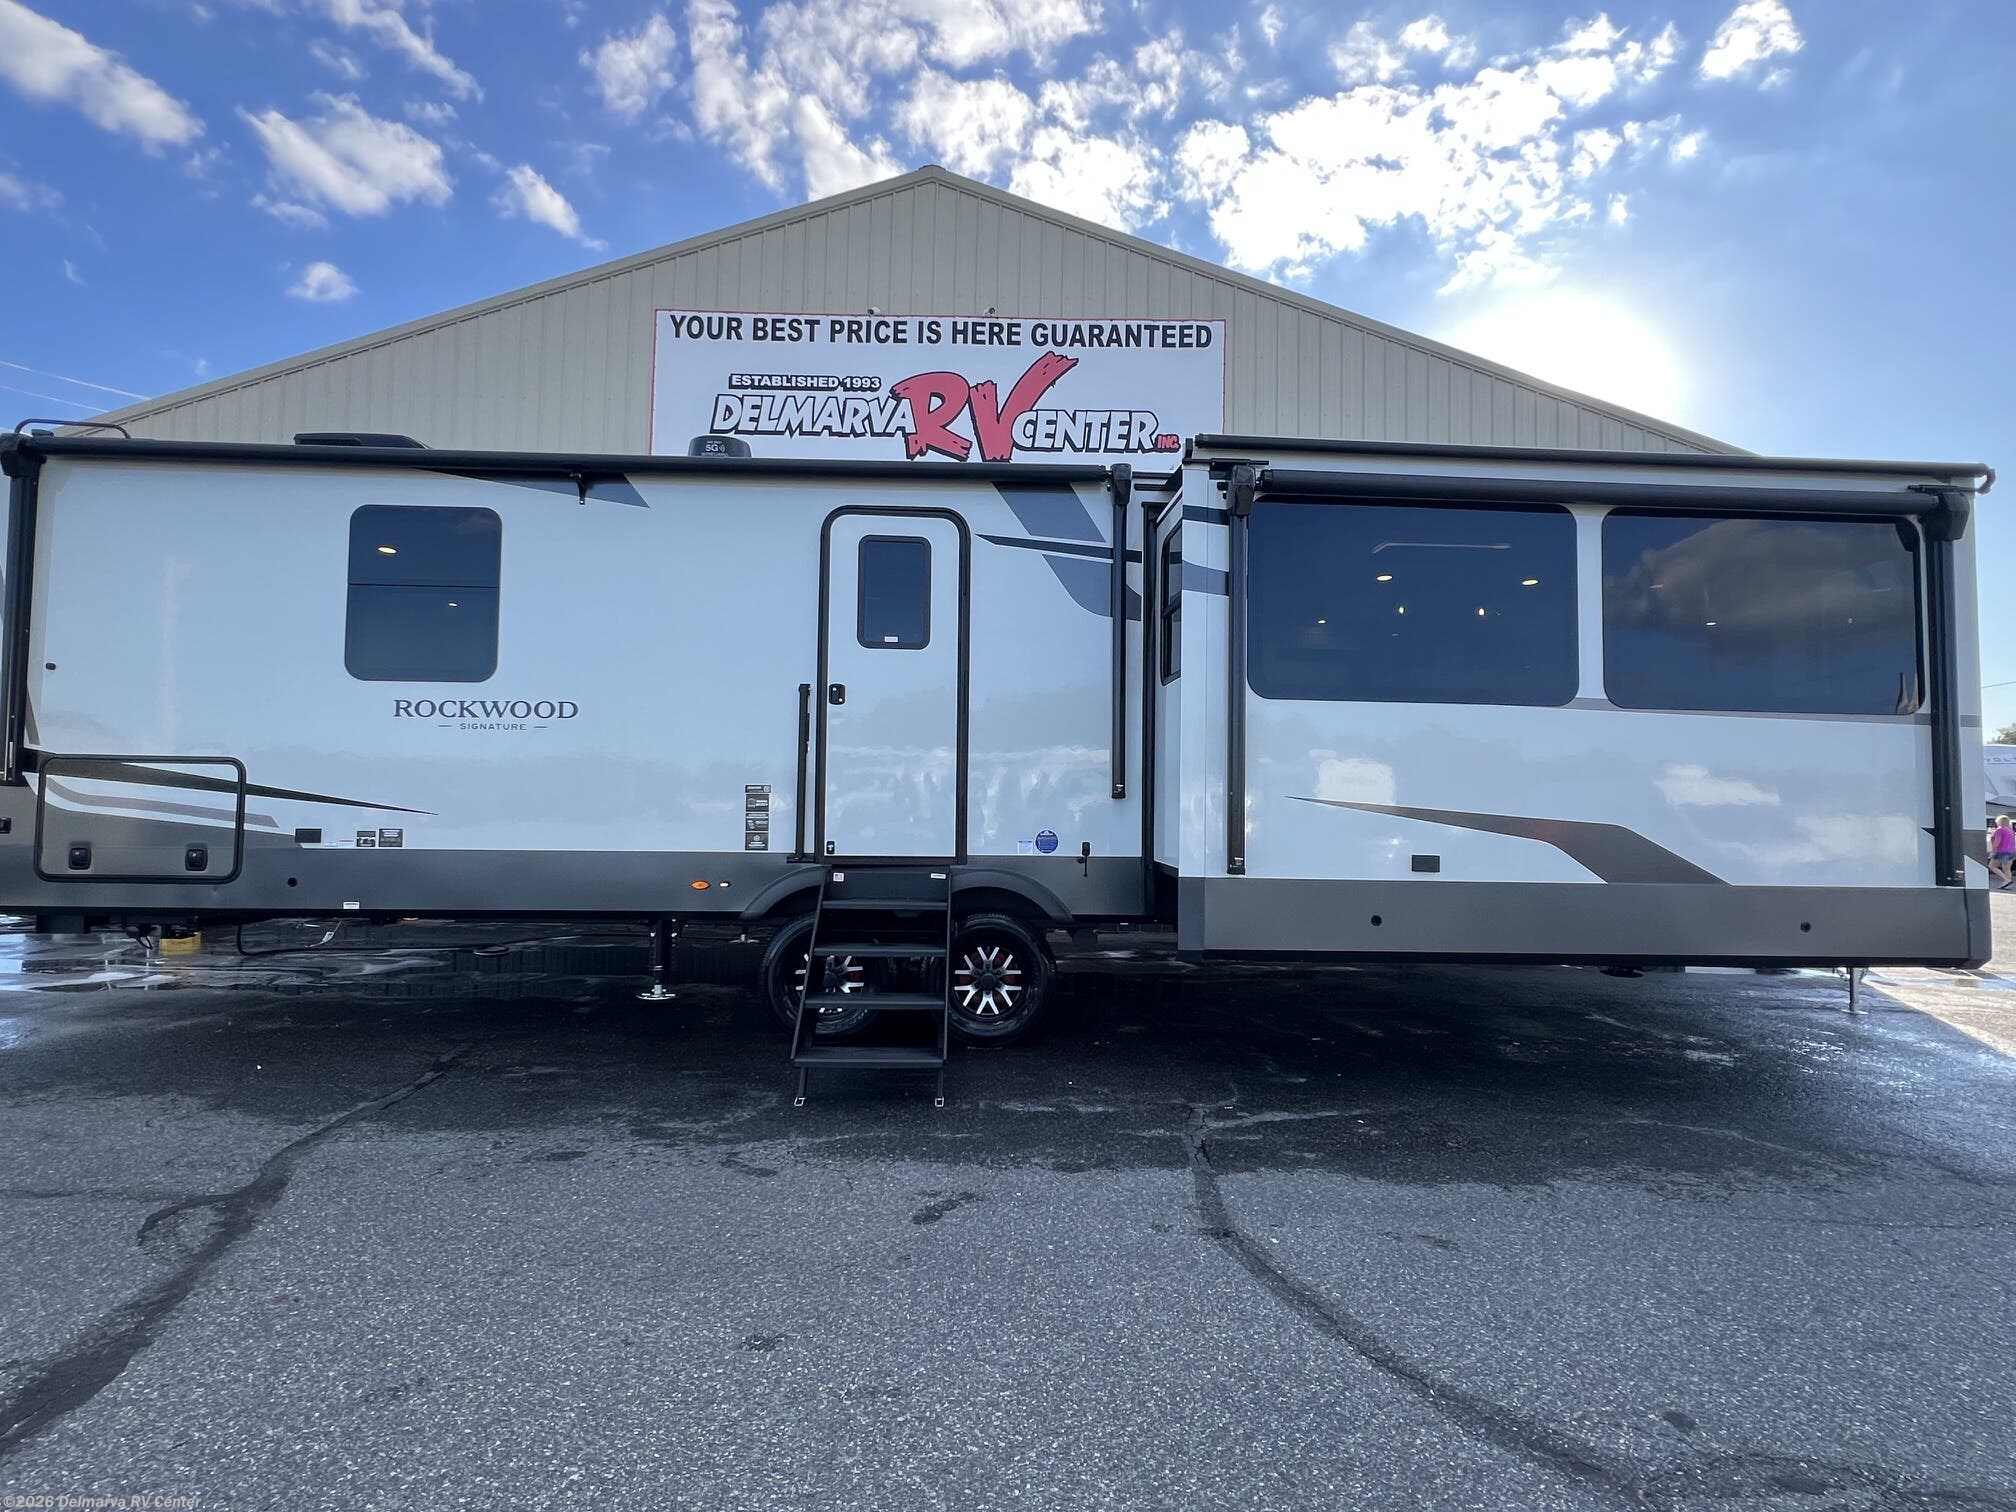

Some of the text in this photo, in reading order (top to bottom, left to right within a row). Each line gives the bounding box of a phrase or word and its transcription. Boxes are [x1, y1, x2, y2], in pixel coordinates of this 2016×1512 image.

[670, 315, 1212, 348] YOUR BEST PRICE IS HERE GUARANTEED
[730, 375, 881, 389] ESTABLISHED 1993
[710, 394, 917, 437] DELMARVA
[889, 351, 1079, 461] RV
[1012, 410, 1158, 452] CENTER
[705, 444, 718, 452] 5G
[394, 700, 579, 719] ROCKWOOD
[460, 723, 527, 731] SIGNATURE
